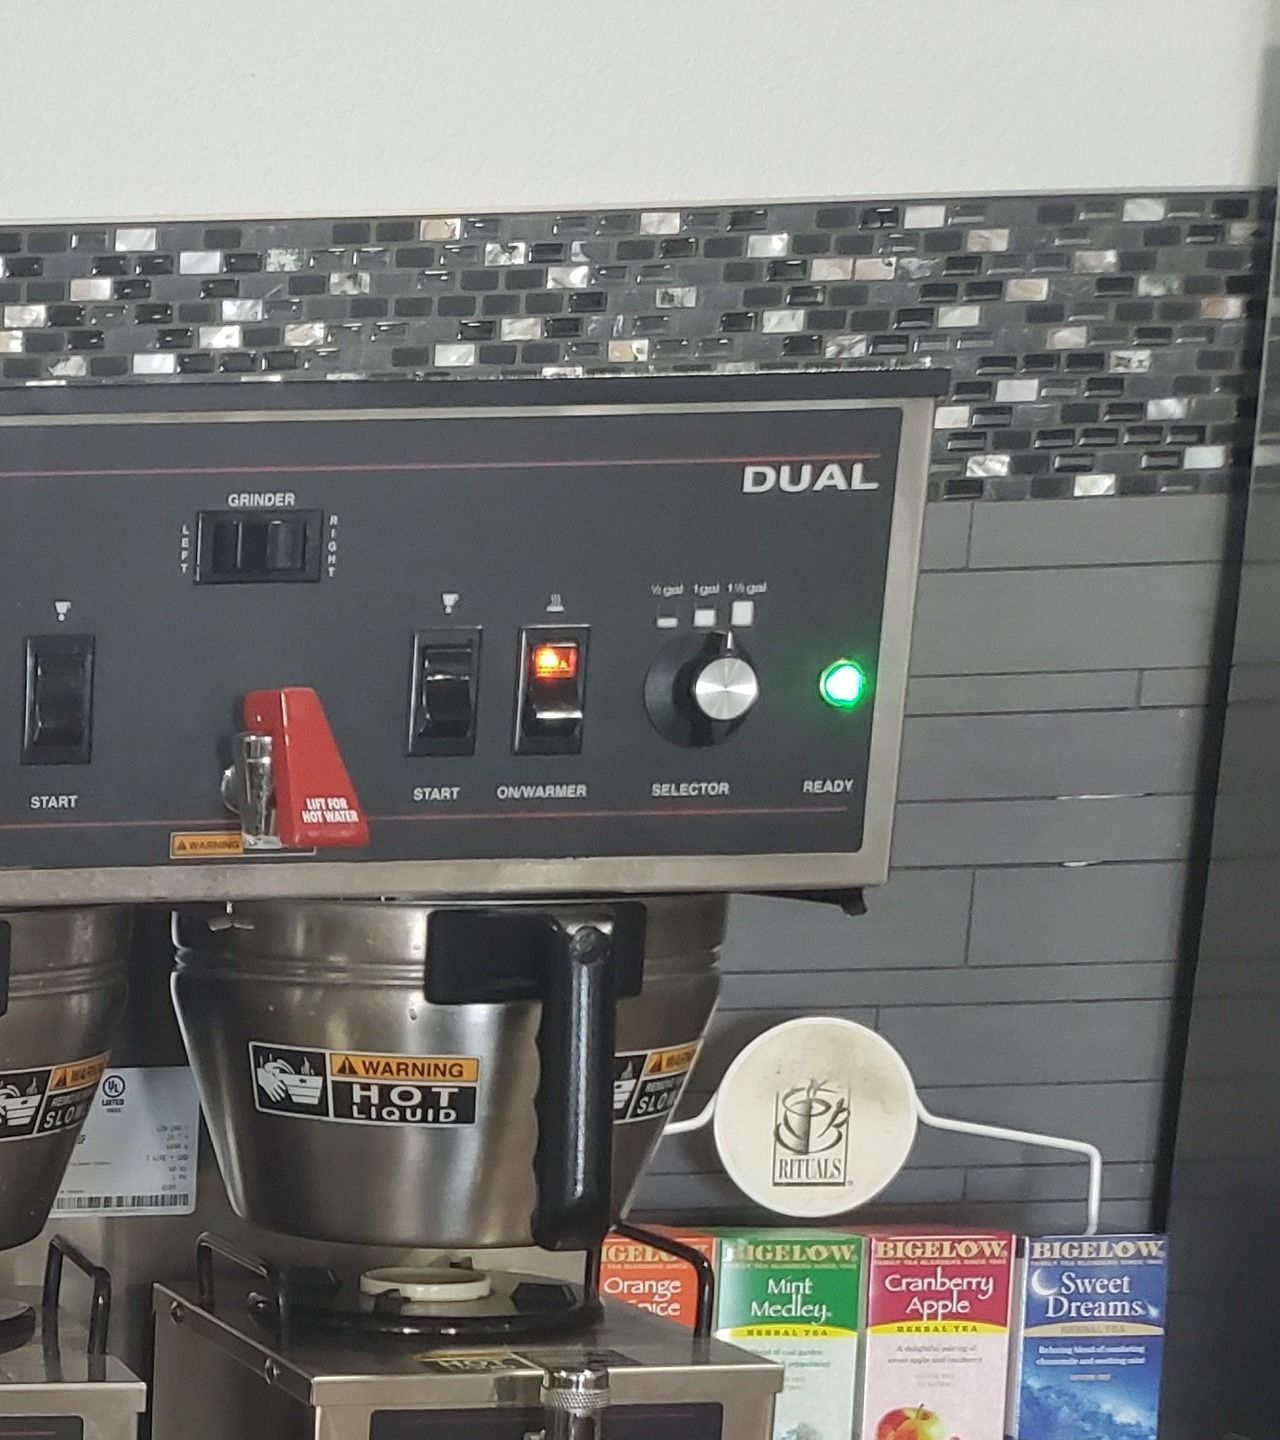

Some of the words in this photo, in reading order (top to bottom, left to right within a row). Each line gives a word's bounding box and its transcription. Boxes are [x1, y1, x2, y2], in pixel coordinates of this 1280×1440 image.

[743, 464, 879, 494] DUAL
[228, 493, 296, 507] GRINDER
[181, 525, 189, 574] LEFT
[327, 515, 338, 577] RIGHT
[413, 786, 460, 801] START
[496, 783, 588, 800] ON/WARMER
[651, 781, 729, 797] SELECTOR
[803, 778, 854, 794] READY
[30, 795, 77, 810] START
[306, 798, 325, 810] LIFT
[327, 797, 348, 809] FOR
[302, 810, 323, 823] HOT
[323, 810, 359, 823] WATER
[189, 841, 240, 850] WARNING
[361, 1059, 464, 1079] WARNING
[352, 1086, 459, 1106] HOT
[352, 1104, 458, 1123] LIQUID
[778, 1157, 842, 1180] RITUALS
[724, 1244, 856, 1261] BIGELOW
[874, 1241, 1007, 1258] BIGELOW
[1030, 1240, 1165, 1258] BIGELOW
[604, 1277, 681, 1301] Orange
[767, 1276, 813, 1294] Mint
[885, 1266, 993, 1300] Cranberry
[1060, 1272, 1131, 1294] Sweet
[751, 1294, 828, 1326] Medley
[905, 1289, 970, 1322] Apple
[1045, 1295, 1146, 1317] Dreams
